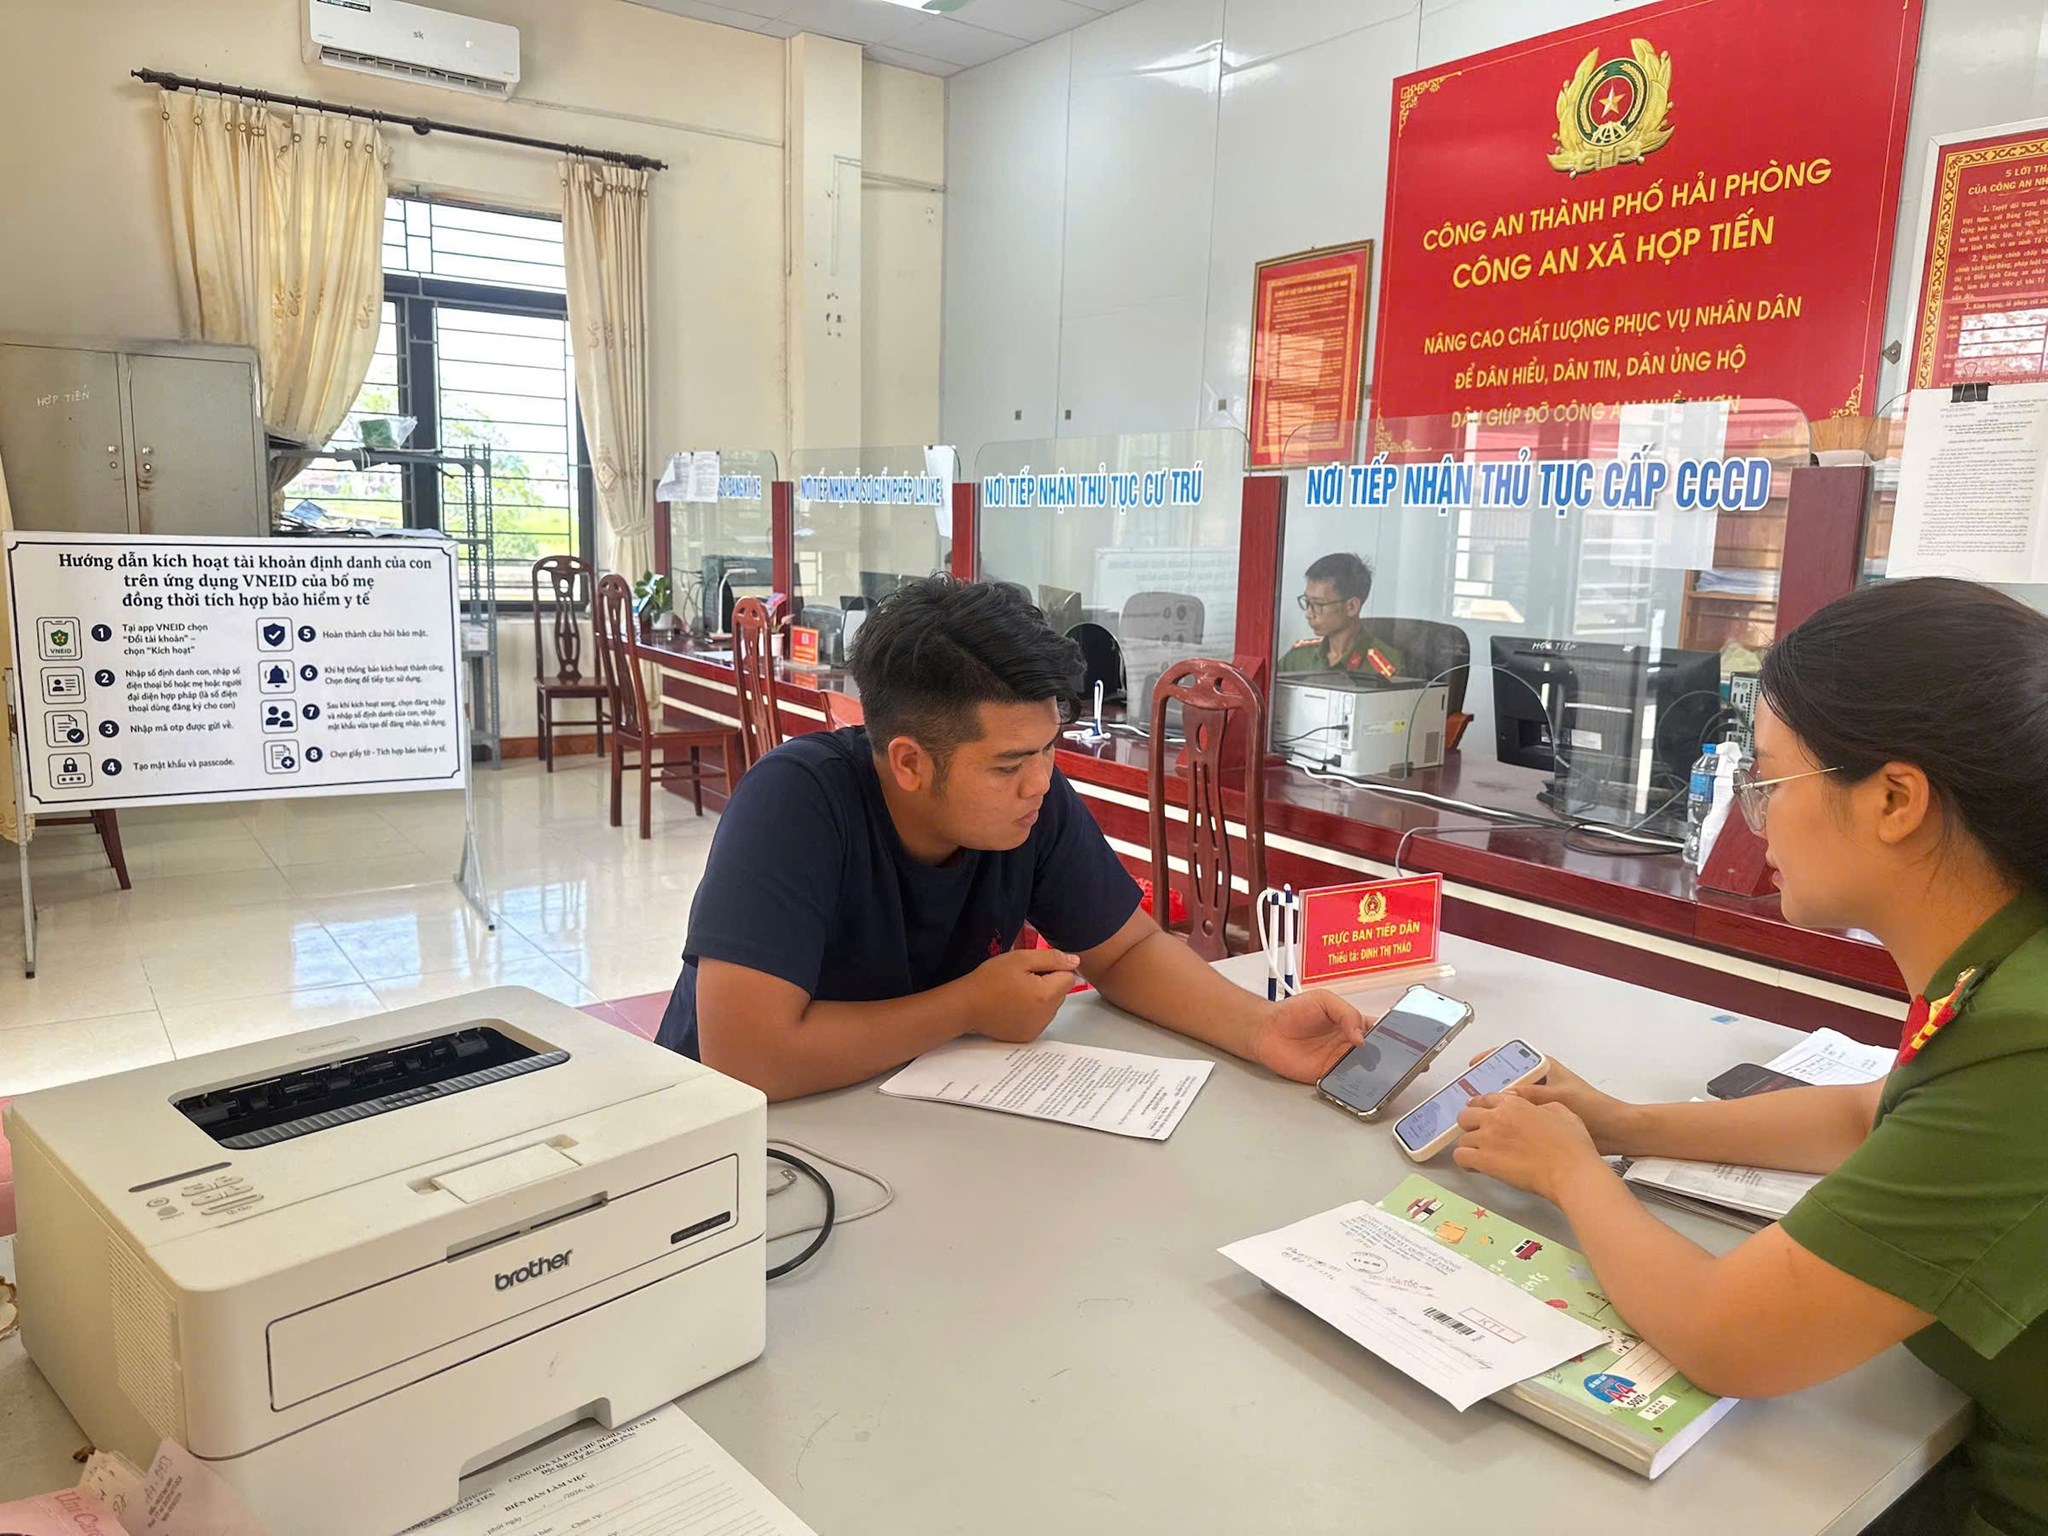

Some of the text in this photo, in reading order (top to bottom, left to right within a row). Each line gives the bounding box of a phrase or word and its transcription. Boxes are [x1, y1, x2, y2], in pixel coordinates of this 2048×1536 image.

[414, 30, 424, 40] sk
[2005, 163, 2048, 178] 5 LỜI TH
[1968, 176, 2048, 195] CỦA CÔNG AN NH
[1423, 157, 1832, 251] CÔNG AN THÀNH PHỐ HẢI PHÒNG
[1453, 206, 1775, 289] CÔNG AN XÃ HỢP TIẾN
[1423, 293, 1803, 355] NÂNG CAO CHẤT LƯỢNG PHỤC VỤ NHÂN DÂN
[1455, 343, 1748, 390] ĐỂ DÂN HIỂU, DÂN TIN, DÂN ỦNG HỘ
[37, 384, 90, 408] HỢP TIẾN
[1486, 401, 1521, 427] GIÚP
[1523, 399, 1549, 425] ĐỠ
[1553, 397, 1606, 422] CÔNG
[929, 475, 943, 505] XE
[984, 460, 1203, 515] NƠI TIẾP NHẬN THỦ TỤC CƯ TRÚ
[1305, 445, 1771, 518] NƠI TIẾP NHẬN THỦ TỤC CẤP CCCD
[59, 553, 432, 571] Hướng dẫn kích hoạt tài khoản định danh của con
[124, 573, 374, 590] trên ứng dụng VNEID của bố mẹ
[122, 591, 370, 610] đồng thời tích hợp bảo hiểm y tế
[98, 627, 104, 638] 1
[122, 624, 136, 633] Tại
[188, 623, 208, 632] chọn
[303, 629, 311, 639] 5
[124, 647, 145, 656] chọn
[101, 673, 110, 683] 2
[308, 708, 316, 717] 7
[105, 724, 113, 734] 3
[310, 750, 318, 759] 8
[107, 762, 116, 772] 4
[133, 763, 148, 771] Tạo
[1322, 919, 1421, 947] TRỰC BAN TIẾP DÂN
[1328, 950, 1347, 965] Thiếu
[1380, 945, 1391, 957] THỊ
[494, 1249, 574, 1291] brother
[1604, 1383, 1638, 1403] A4
[504, 1472, 588, 1512] BIÊN BẢN LÀM VIỆC
